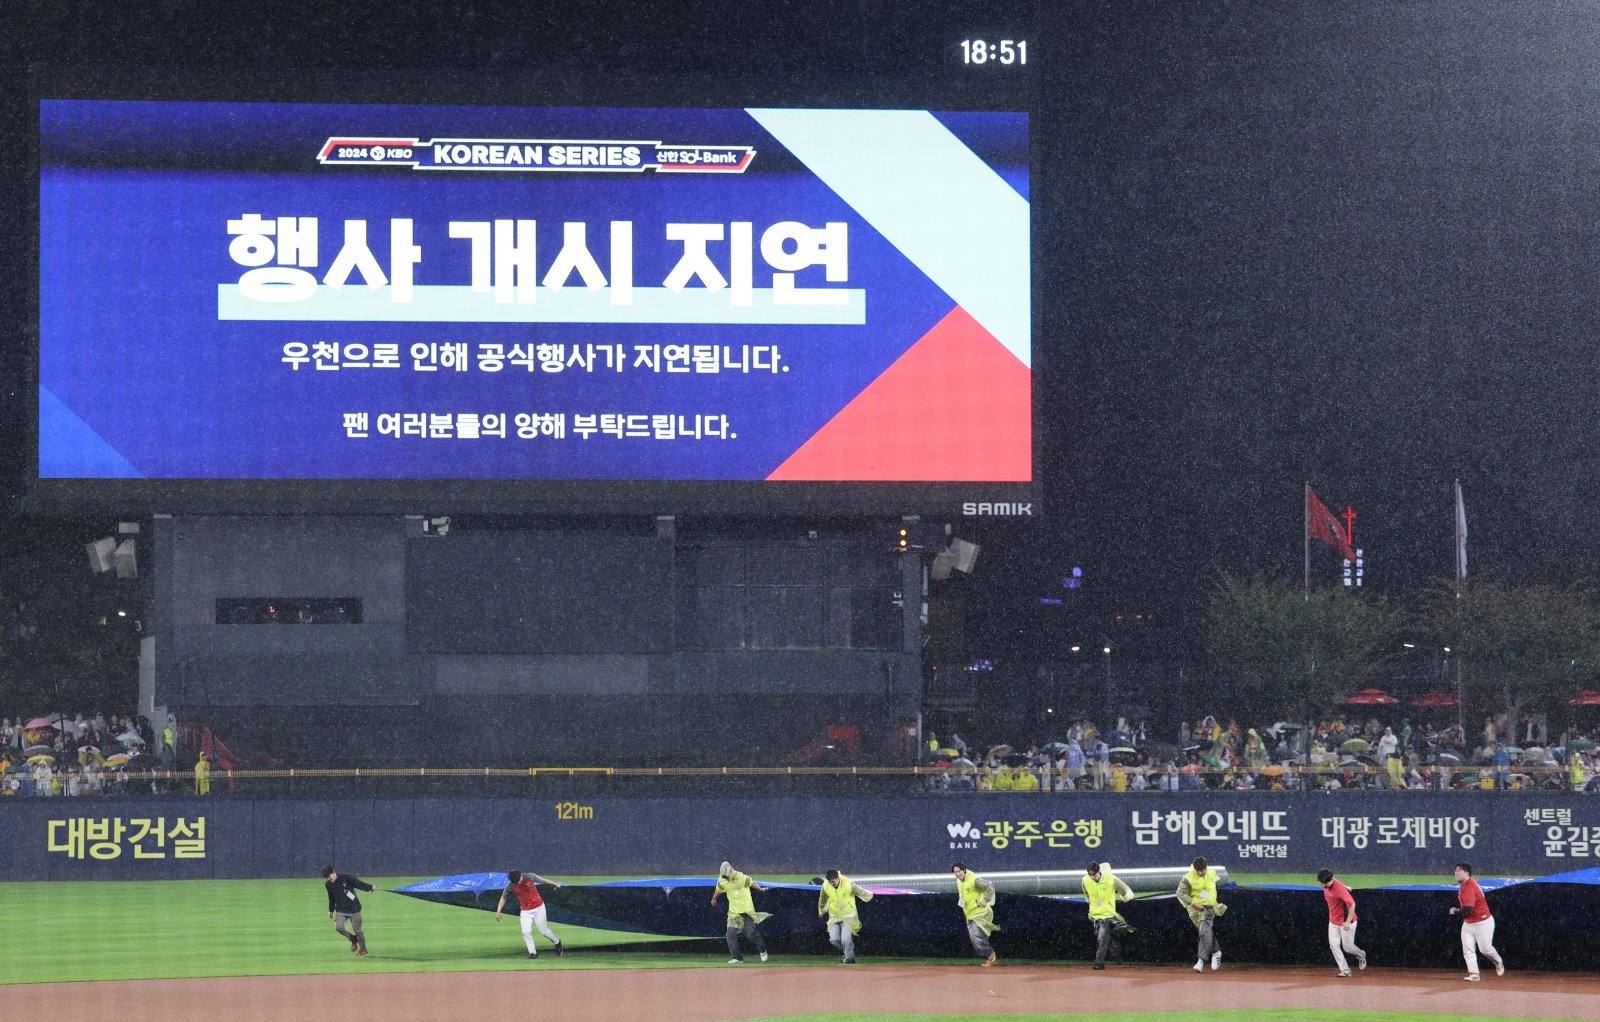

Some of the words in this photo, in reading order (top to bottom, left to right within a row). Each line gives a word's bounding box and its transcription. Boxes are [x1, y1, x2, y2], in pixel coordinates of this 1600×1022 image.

[960, 39, 1027, 65] 18:51
[337, 147, 369, 159] 2024
[386, 148, 413, 159] KBO
[433, 143, 544, 166] KOREAN
[548, 145, 642, 167] SERIES
[702, 151, 737, 164] Bank
[227, 213, 422, 303] 행사
[448, 218, 634, 306] 개시
[663, 220, 850, 307] 지연
[281, 341, 401, 372] 우천으로
[409, 342, 469, 373] 인해
[476, 343, 627, 373] 공식행사가
[633, 344, 791, 375] 지연됩니다.
[342, 412, 369, 439] 팬
[376, 412, 507, 440] 여러분들의
[513, 412, 566, 440] 양해
[572, 413, 738, 440] 부탁드립니다.
[962, 502, 1033, 516] SAMIK
[554, 801, 594, 820] 121m
[1523, 808, 1572, 826] 센트럴
[47, 816, 206, 860] 대방건설
[982, 818, 1103, 849] 광주은행
[1131, 810, 1291, 846] 남해오네뜨
[1320, 816, 1373, 850] 대광
[1376, 816, 1480, 850] 로제비앙
[1237, 844, 1288, 858] 남해건설
